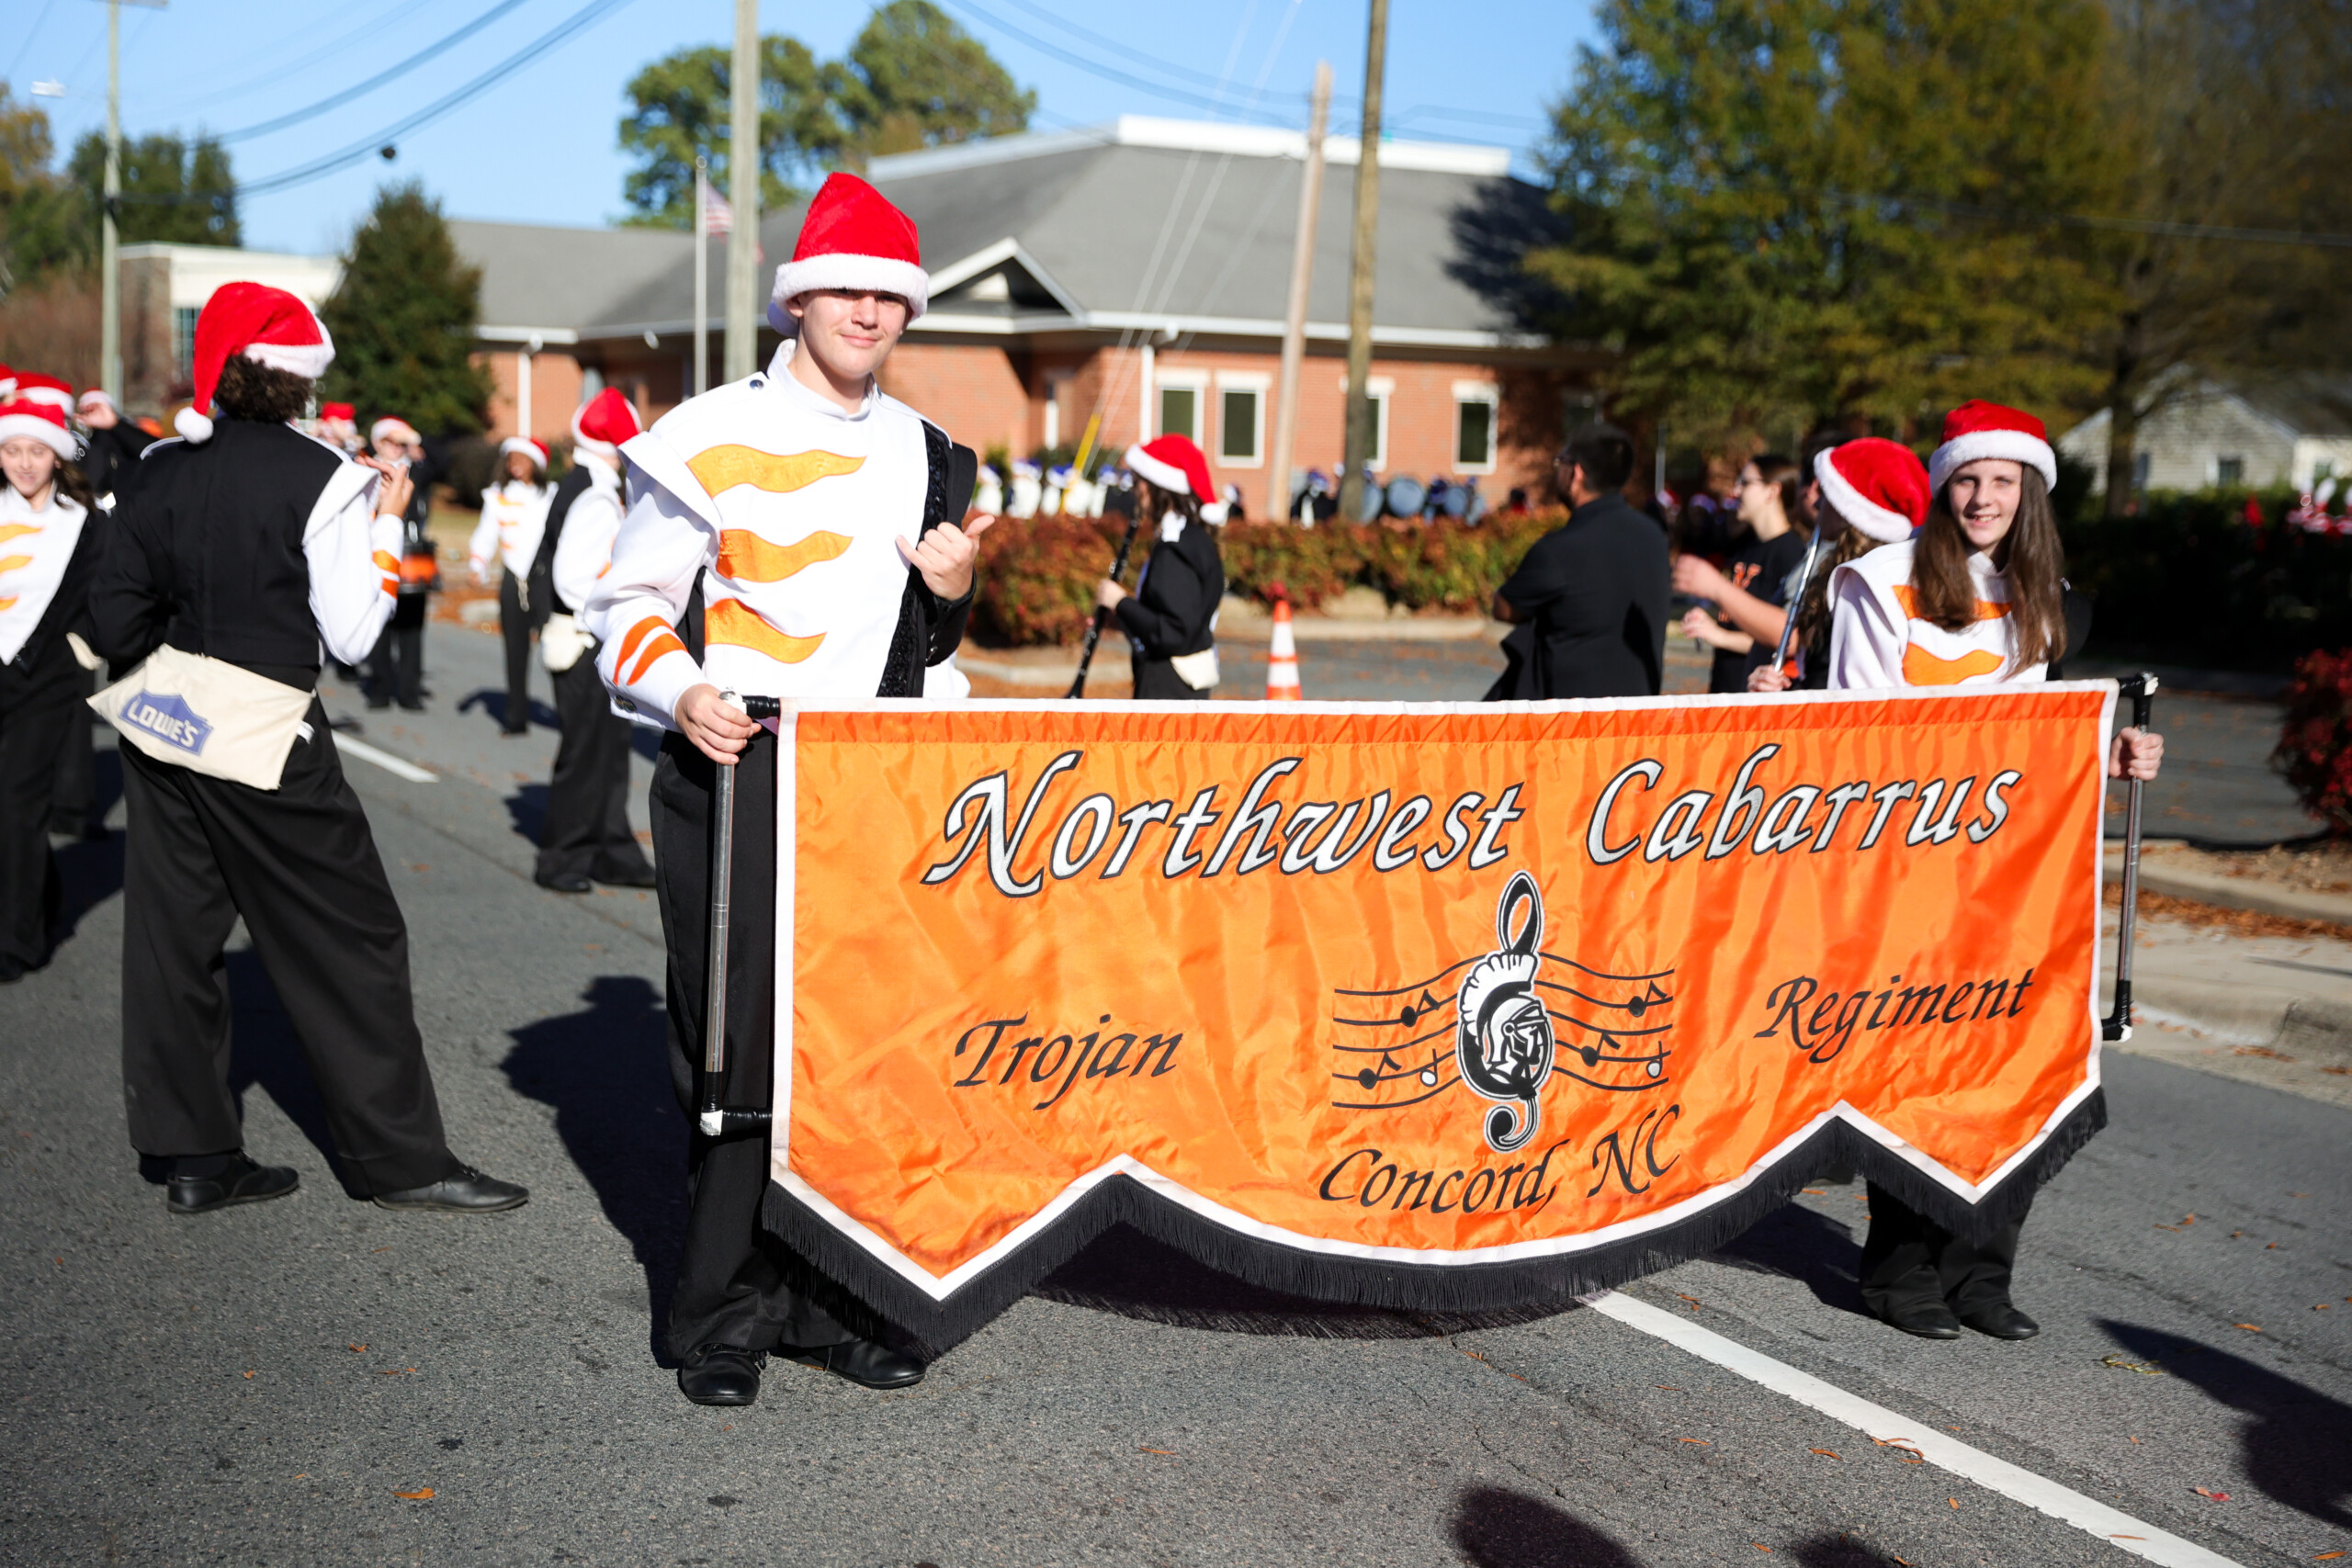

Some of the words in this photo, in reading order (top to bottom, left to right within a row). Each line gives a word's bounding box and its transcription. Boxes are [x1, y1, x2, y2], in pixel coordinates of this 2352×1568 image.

[127, 695, 199, 749] LOWE'S
[920, 749, 1527, 898] Northwest
[1586, 743, 2022, 866] Cabarrus
[953, 1010, 1183, 1111] Trojan
[1752, 967, 2036, 1064] Regiment
[1318, 1138, 1570, 1214] Concord,
[1586, 1104, 1680, 1198] NC
